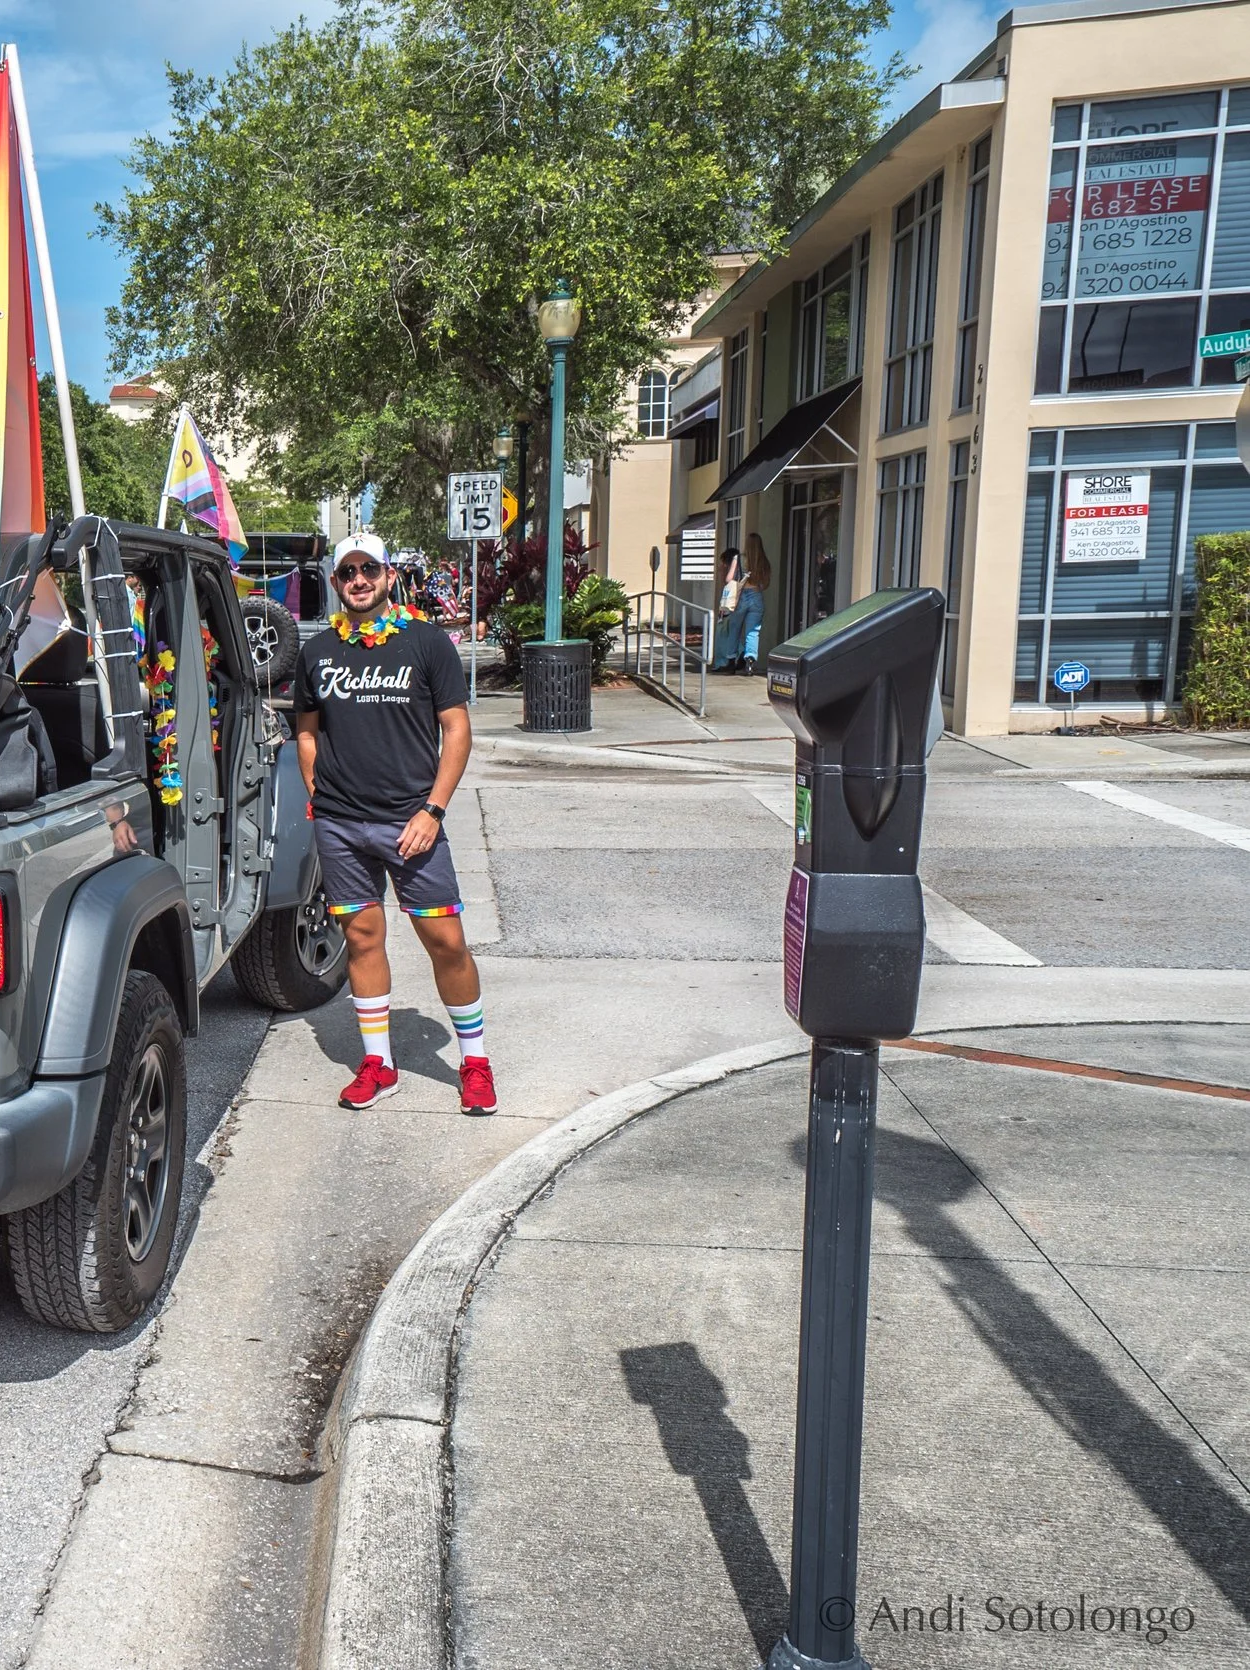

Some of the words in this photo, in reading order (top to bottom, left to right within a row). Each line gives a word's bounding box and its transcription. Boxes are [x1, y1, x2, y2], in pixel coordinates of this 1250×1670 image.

[1087, 147, 1175, 164] OMMERCIAL
[1119, 162, 1173, 177] ESTATE
[1117, 176, 1201, 199] LEASE
[1066, 199, 1136, 219] ,682
[1150, 195, 1180, 211] SF
[1054, 222, 1098, 234] Jaon
[1104, 214, 1187, 230] D'Agostino
[1093, 231, 1135, 251] 685
[1143, 227, 1192, 247] 1228
[1061, 264, 1089, 277] Kn
[1094, 259, 1177, 275] D'Agostino
[1042, 281, 1068, 299] 94
[1082, 276, 1123, 295] 320
[1129, 271, 1188, 292] 0044
[454, 480, 498, 492] SPEED
[1084, 475, 1132, 489] SHORE
[458, 493, 492, 505] LIMIT
[1070, 508, 1096, 517] FOR
[1102, 506, 1144, 516] LEASE
[459, 507, 491, 531] 15
[1097, 519, 1138, 527] D'Agostino
[1070, 528, 1089, 537] 941
[1092, 526, 1113, 536] 685
[1117, 525, 1141, 535] 1228
[1068, 549, 1086, 558] 941
[1088, 547, 1108, 557] 320
[1110, 546, 1140, 556] 0044
[319, 658, 333, 667] SRQ
[318, 666, 412, 699] Kickball
[1061, 670, 1084, 684] ADT
[356, 694, 380, 703] LGBTQ
[382, 694, 410, 704] League
